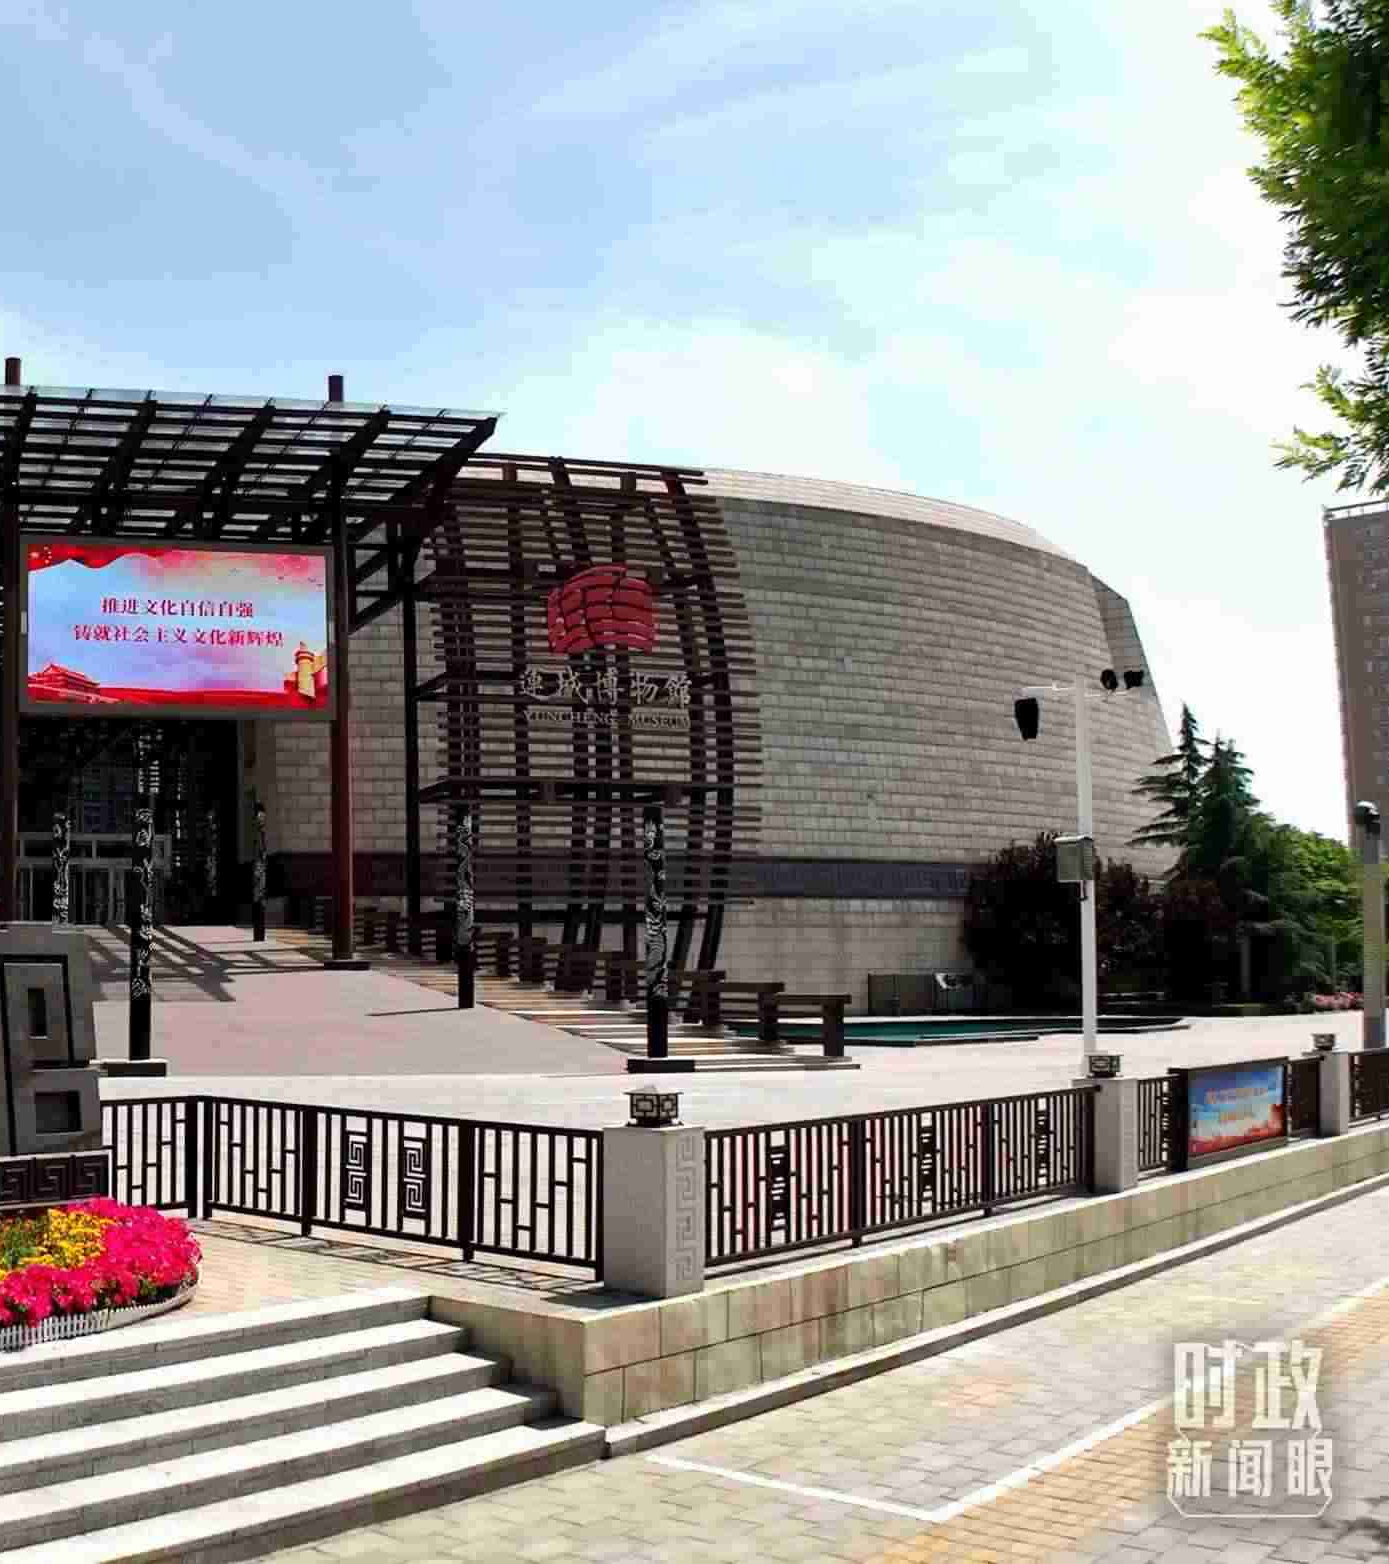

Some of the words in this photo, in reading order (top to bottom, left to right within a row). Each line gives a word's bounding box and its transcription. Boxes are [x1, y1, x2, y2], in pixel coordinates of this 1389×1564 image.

[100, 597, 254, 618] 推进文化自信自强
[73, 625, 285, 647] 铸就社会主义文化新辉煌
[523, 711, 619, 726] YUNCHENG
